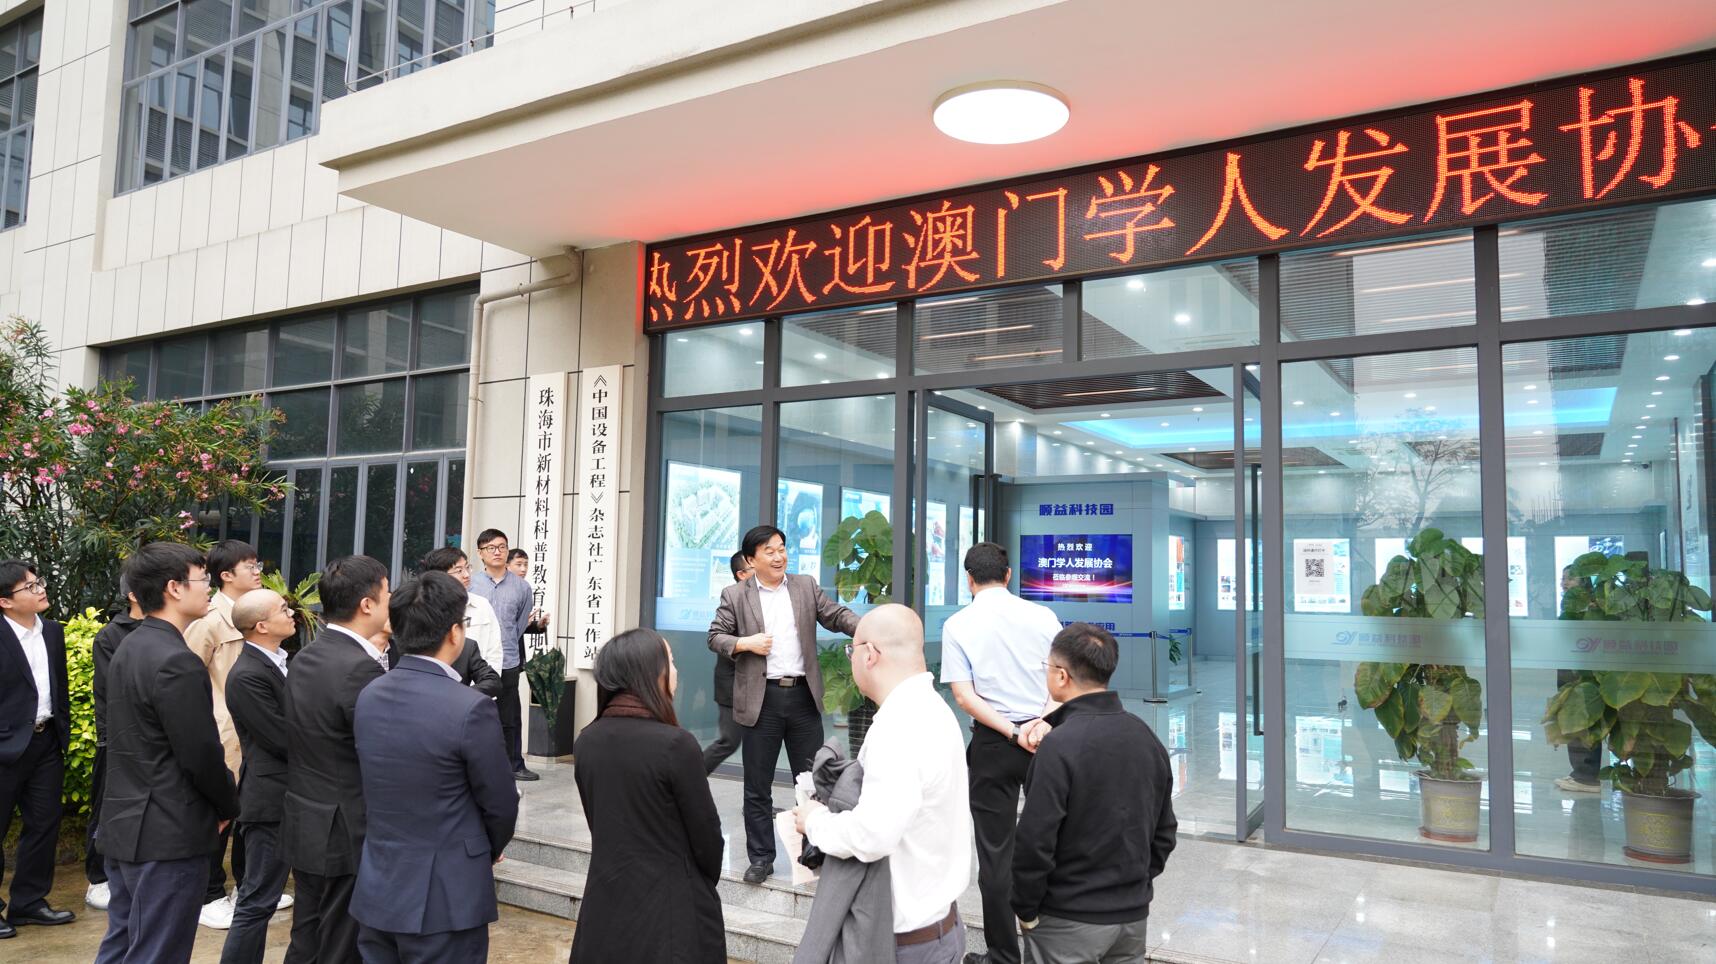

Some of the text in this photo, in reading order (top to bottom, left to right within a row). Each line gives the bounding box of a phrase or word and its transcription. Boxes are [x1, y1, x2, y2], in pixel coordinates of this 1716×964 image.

[650, 78, 1716, 321] 烈欢迎澳门学人发展协
[584, 374, 608, 661] 《中国设备工程》杂志社广东省工作站
[1038, 557, 1113, 568] 澳门学人发展协会
[1057, 543, 1093, 551] 热烈欢迎
